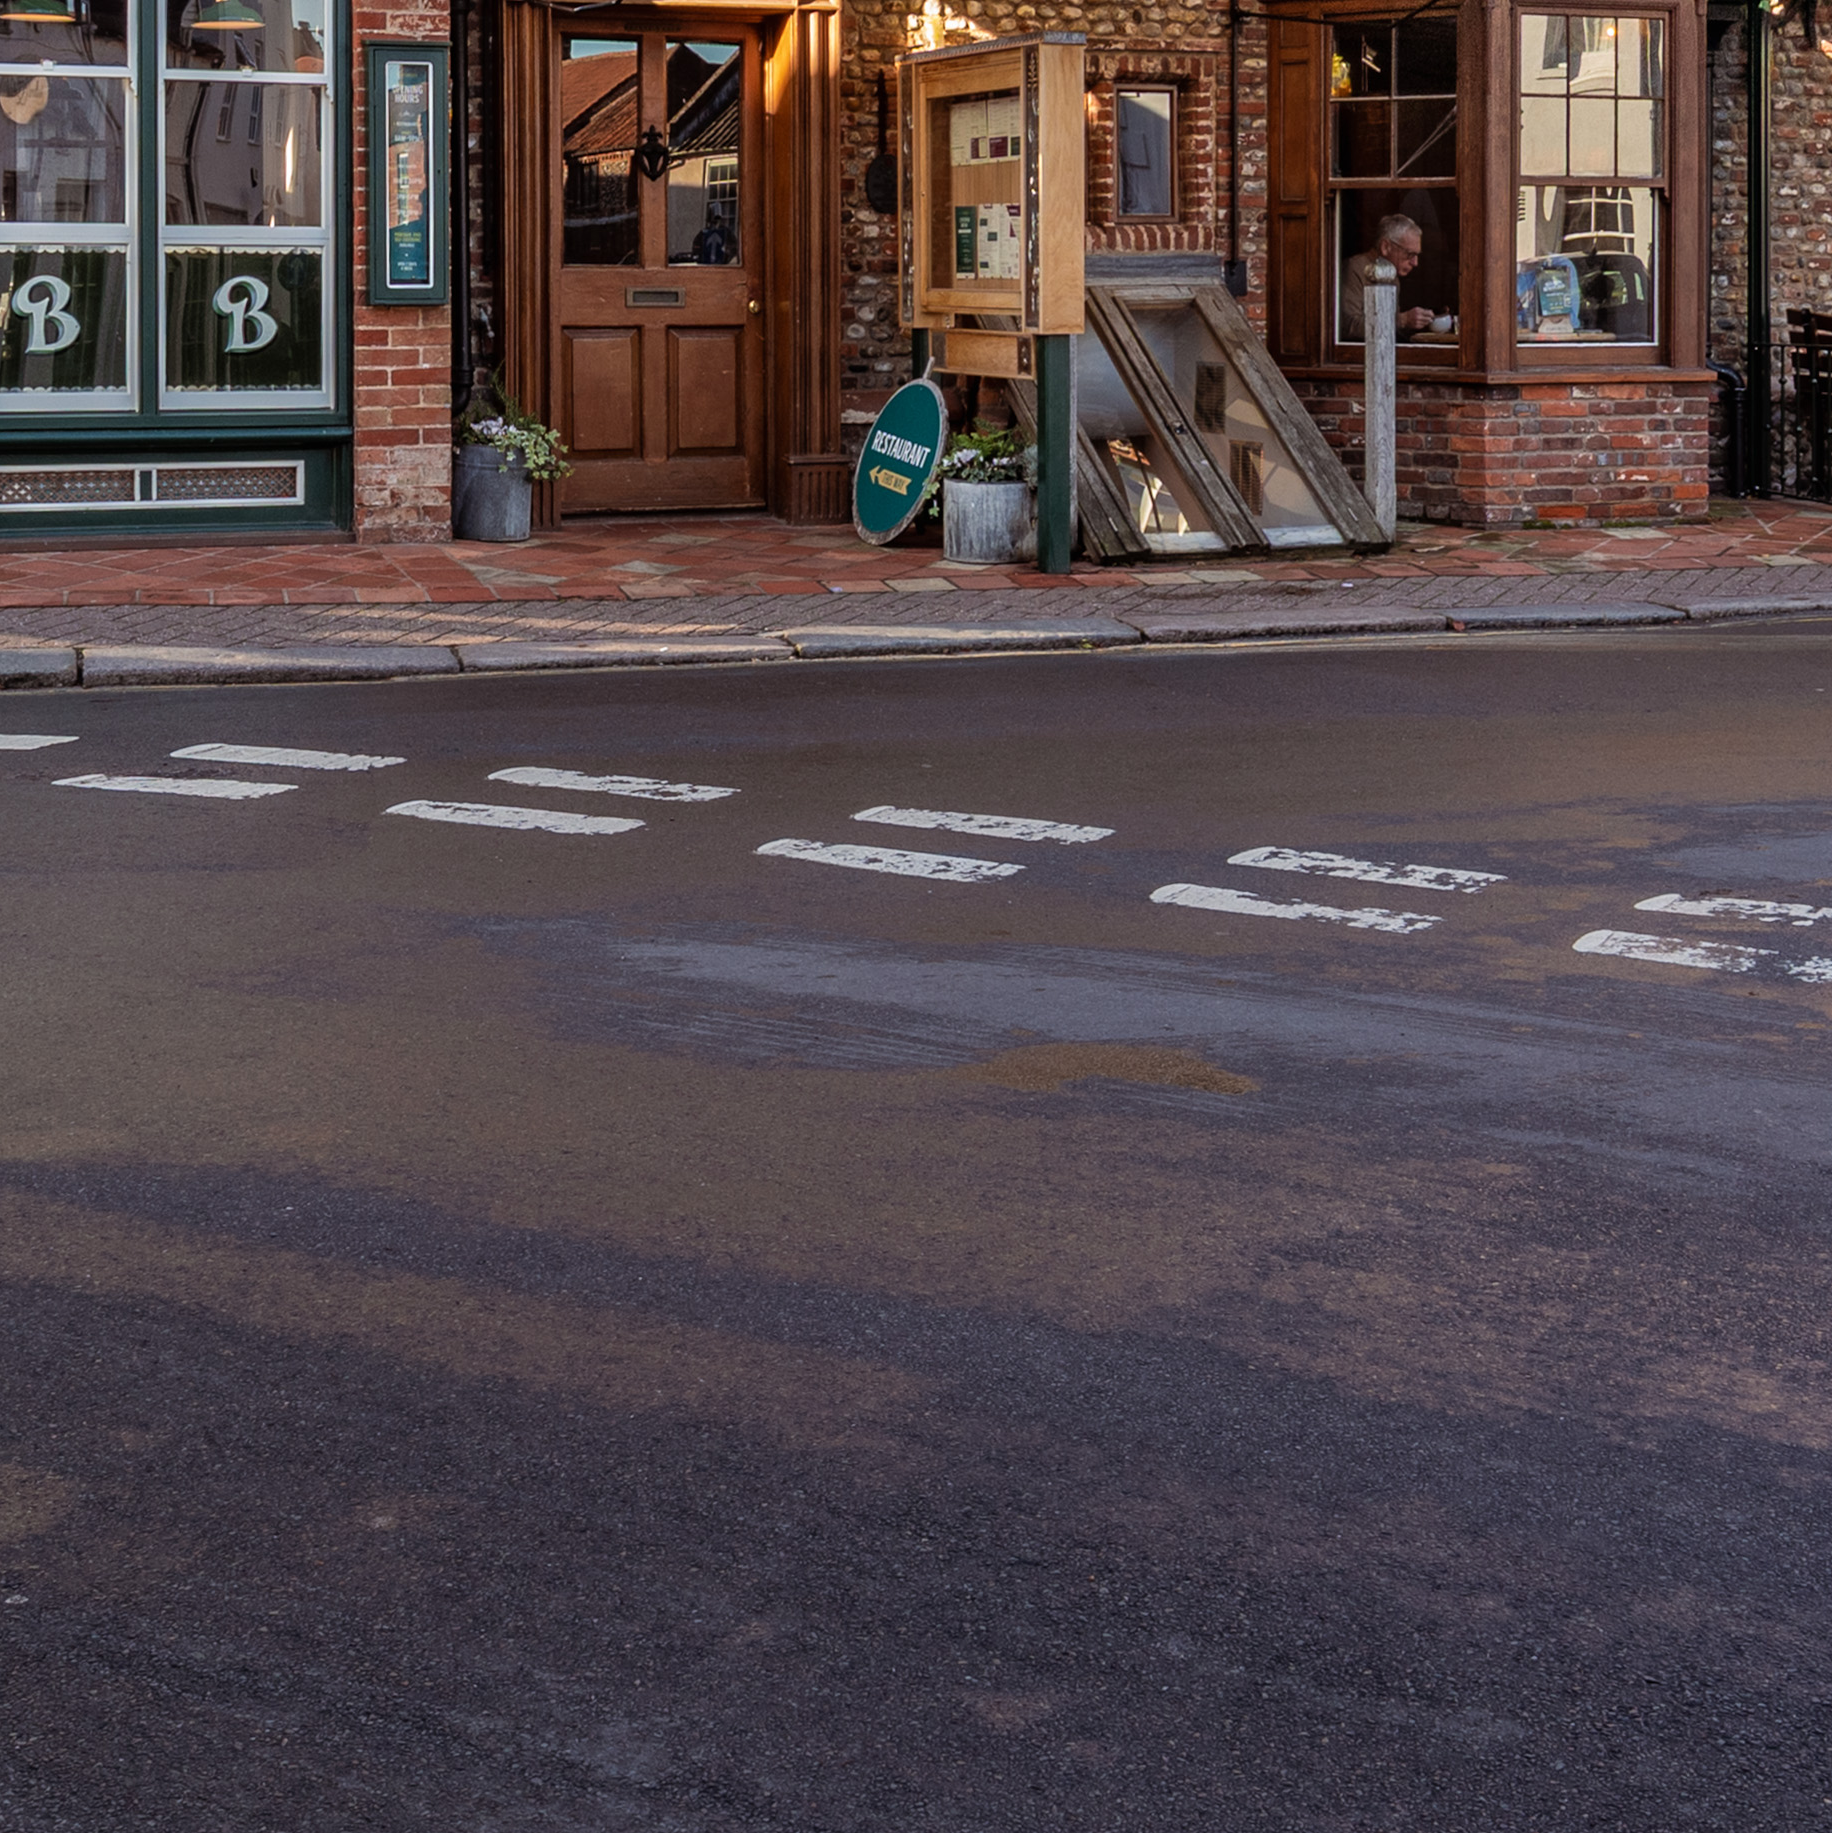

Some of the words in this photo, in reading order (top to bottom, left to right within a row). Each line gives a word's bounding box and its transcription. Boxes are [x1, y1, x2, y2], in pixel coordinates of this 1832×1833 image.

[12, 274, 81, 355] B
[212, 274, 279, 354] B
[871, 430, 931, 469] RESTAURANT
